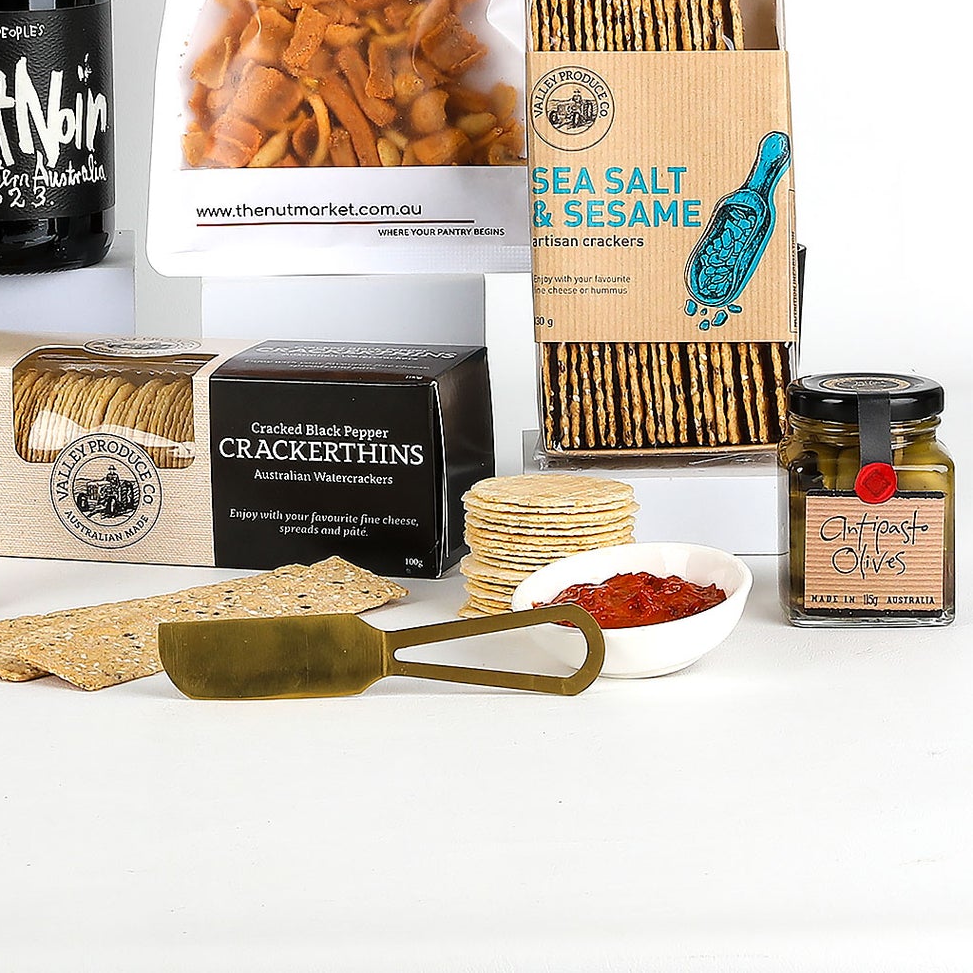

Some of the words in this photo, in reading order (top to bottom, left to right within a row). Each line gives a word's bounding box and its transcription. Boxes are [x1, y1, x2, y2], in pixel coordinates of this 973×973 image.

[533, 74, 558, 119] VALLEY
[558, 70, 608, 101] PRODUCE
[32, 149, 107, 190] Australia
[532, 167, 595, 195] SEA
[604, 166, 687, 195] SALT
[196, 202, 423, 218] www.thenutmarket.com.au
[532, 200, 552, 227] &
[563, 199, 702, 228] SESAME
[377, 228, 410, 237] WHERE
[410, 228, 436, 237] YOUR
[437, 228, 472, 237] PANTRY
[473, 227, 505, 236] BEGINS
[533, 234, 579, 247] artisan
[583, 234, 645, 247] crackers
[555, 274, 573, 283] with
[574, 276, 593, 285] your
[547, 287, 578, 295] cheese
[590, 287, 628, 295] hummus
[547, 318, 554, 328] g
[251, 421, 303, 436] Cracked
[305, 423, 342, 437] Black
[344, 426, 390, 440] Pepper
[218, 438, 425, 466] CRACKERTHINS
[56, 446, 87, 502] VALLEY
[88, 439, 153, 482] PRODUCE
[254, 469, 312, 482] Australian
[313, 471, 394, 485] Watercrackers
[64, 509, 123, 542] AUSTRALIAN
[125, 514, 149, 539] MADE
[229, 508, 259, 521] Enjoy
[260, 509, 283, 520] with
[284, 513, 310, 524] your
[310, 511, 359, 525] favourite
[360, 513, 381, 526] fine
[382, 514, 420, 527] cheese,
[279, 525, 319, 537] spreads
[321, 525, 341, 536] and
[405, 557, 424, 568] 100g
[832, 544, 907, 579] Olives
[811, 594, 839, 603] MADE
[844, 594, 855, 604] IN
[886, 595, 936, 605] AUSTRALIA
